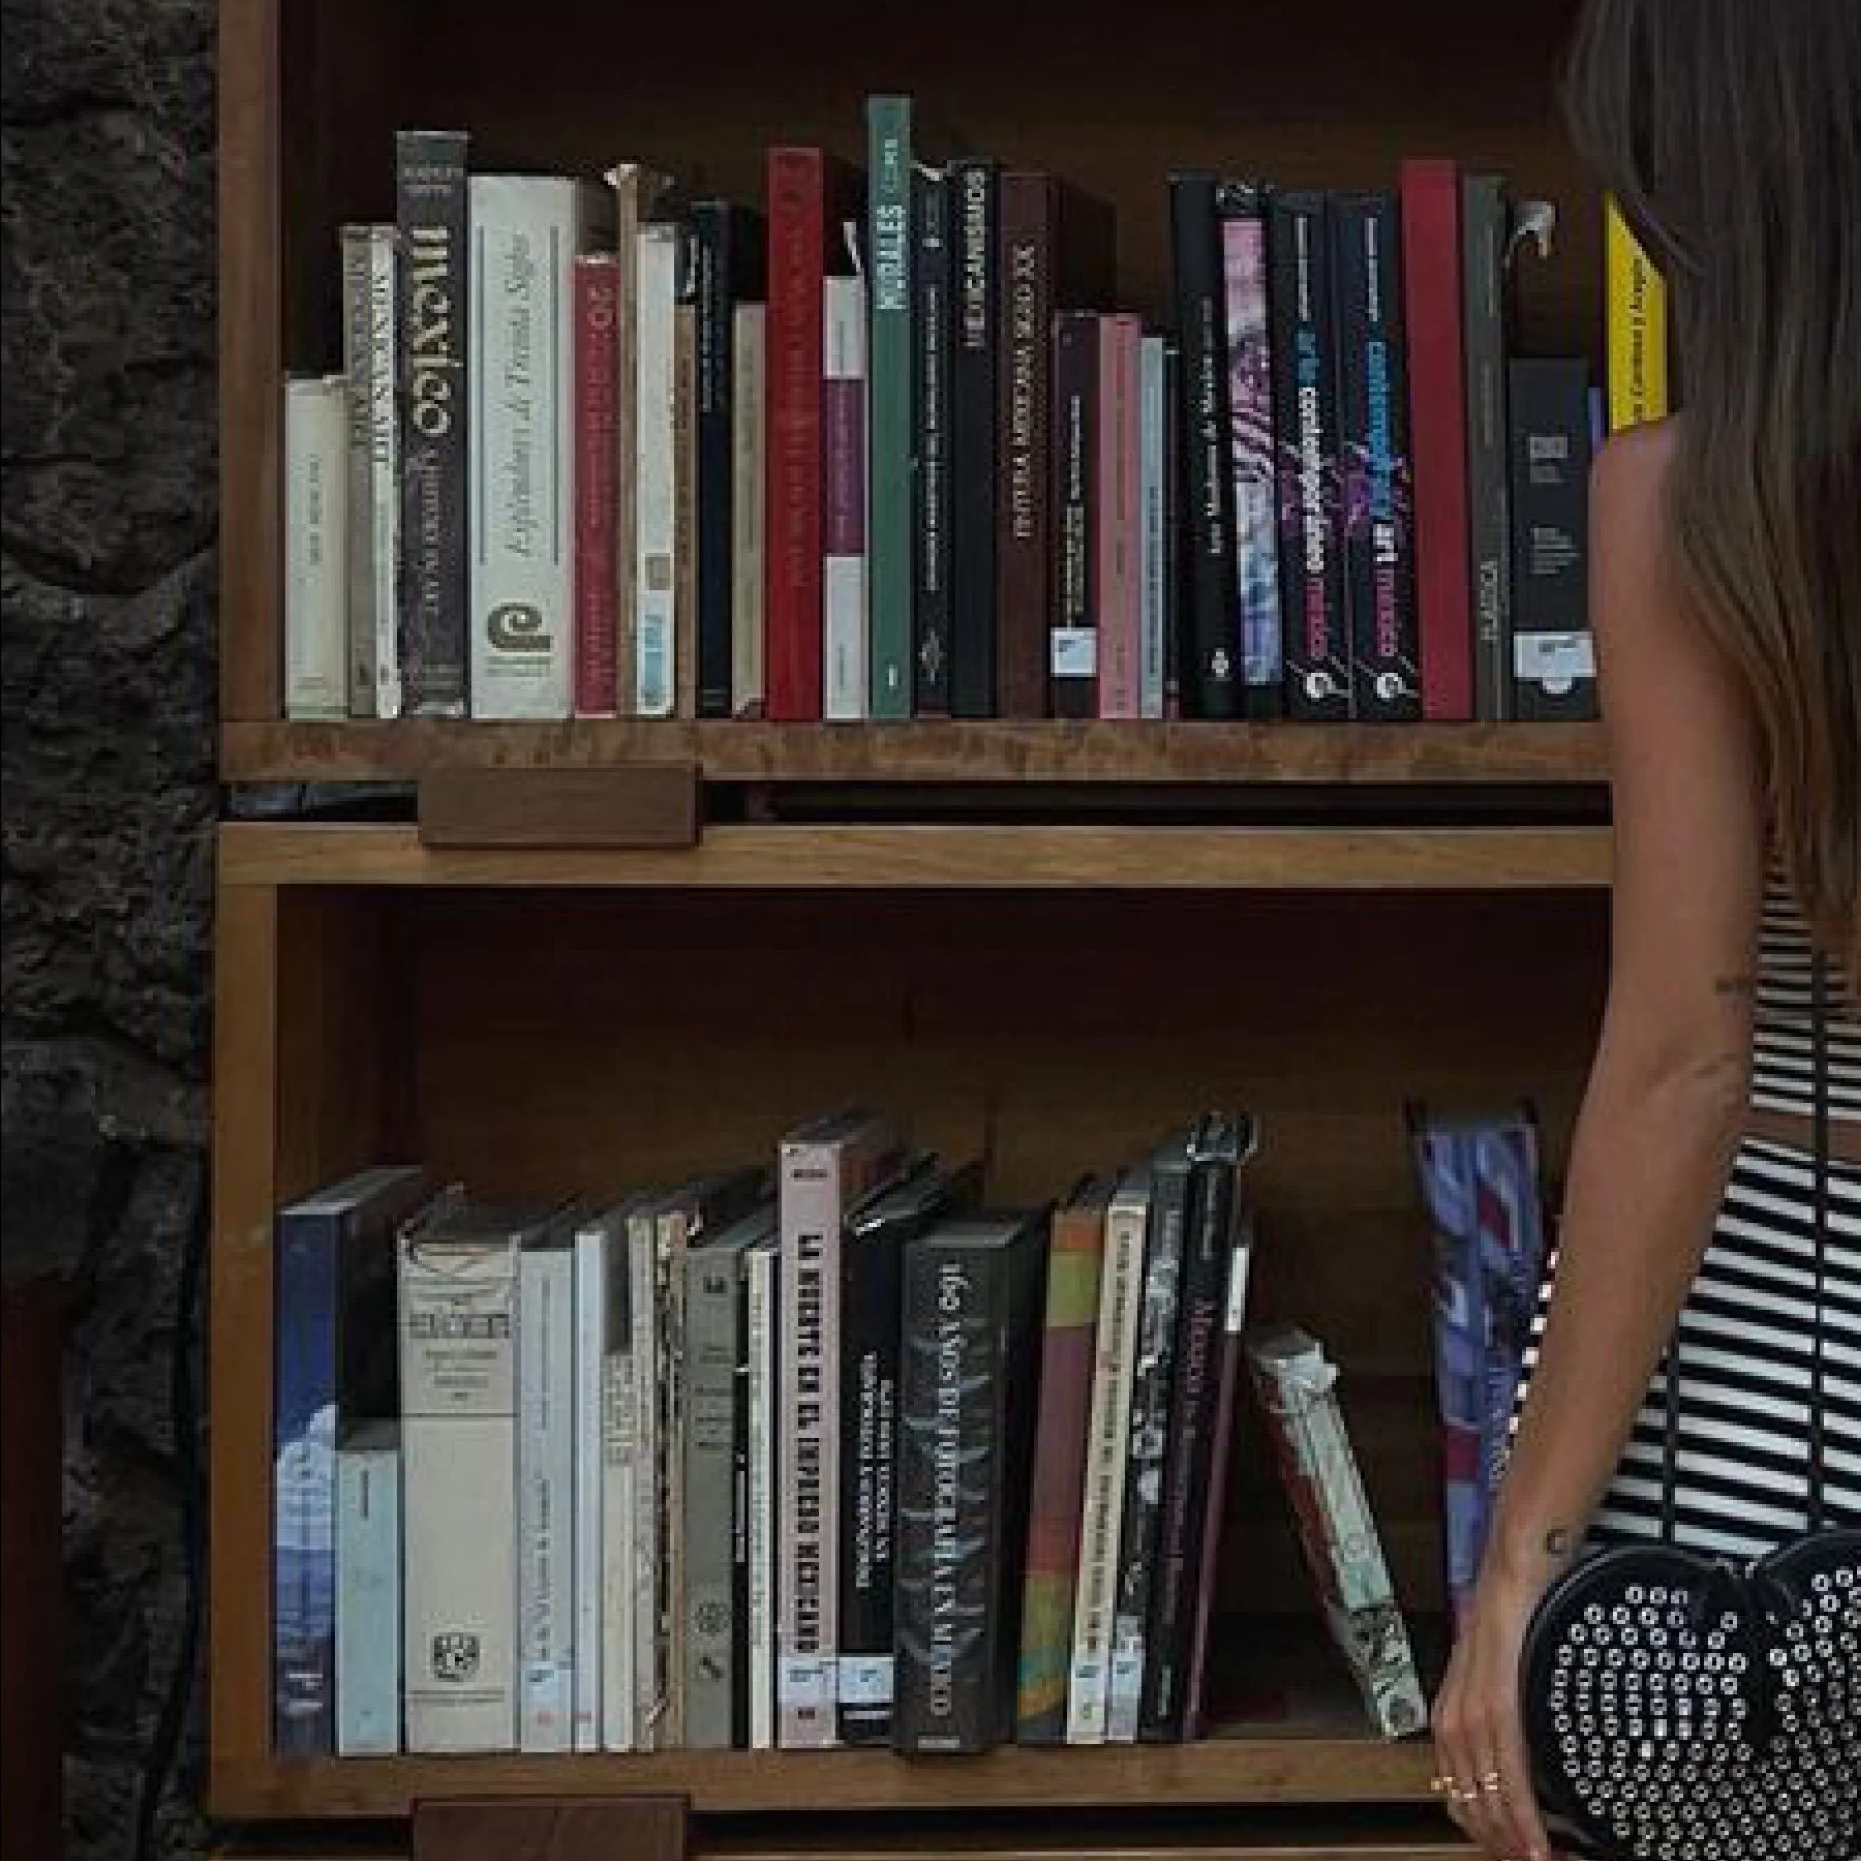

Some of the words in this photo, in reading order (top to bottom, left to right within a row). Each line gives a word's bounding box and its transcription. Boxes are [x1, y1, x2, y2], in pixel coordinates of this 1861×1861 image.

[1012, 244, 1036, 280] XX
[1373, 523, 1399, 563] art
[797, 1234, 823, 1260] LA
[797, 1268, 822, 1357] MUERTE
[797, 1366, 821, 1393] EN
[797, 1403, 821, 1430] EL
[936, 1386, 961, 1422] DE
[797, 1437, 820, 1534] IMPRESO
[796, 1541, 820, 1654] MEXICANO
[932, 1585, 957, 1615] EN
